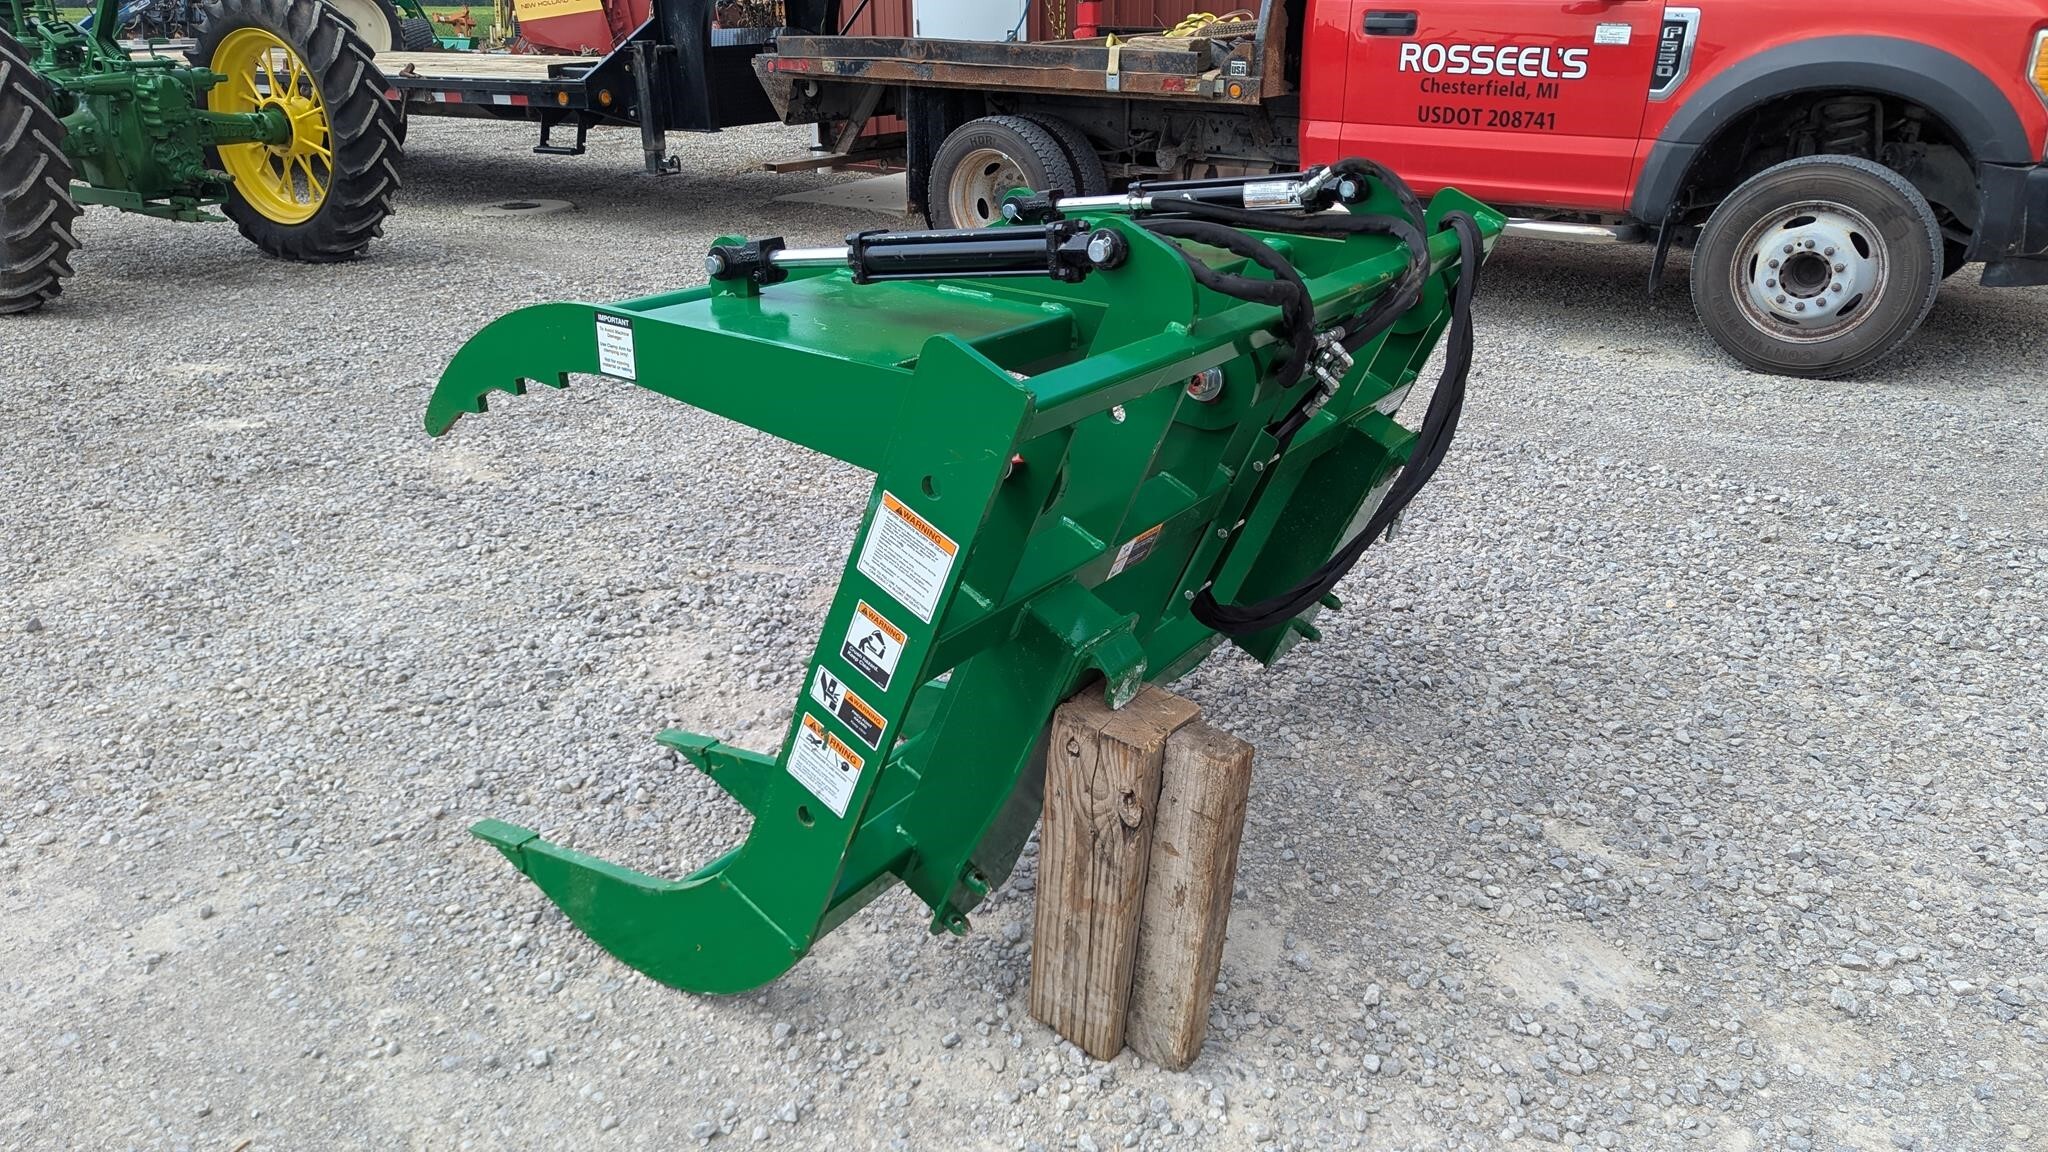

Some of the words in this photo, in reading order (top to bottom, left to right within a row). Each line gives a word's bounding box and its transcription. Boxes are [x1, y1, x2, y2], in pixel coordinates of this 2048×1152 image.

[1232, 66, 1246, 74] USA
[1399, 43, 1589, 79] ROSSEEL'S
[1420, 78, 1531, 100] Chesterfield,
[1536, 82, 1559, 99] MI
[1418, 105, 1483, 126] USDOT
[1487, 109, 1556, 130] 208741
[598, 314, 629, 327] IMPORTANT
[902, 510, 941, 544] WARNING
[867, 610, 901, 641] WARNING
[846, 649, 858, 662] Keep
[848, 644, 862, 659] Crush
[853, 698, 881, 725] WARNING
[816, 726, 857, 764] WRNING
